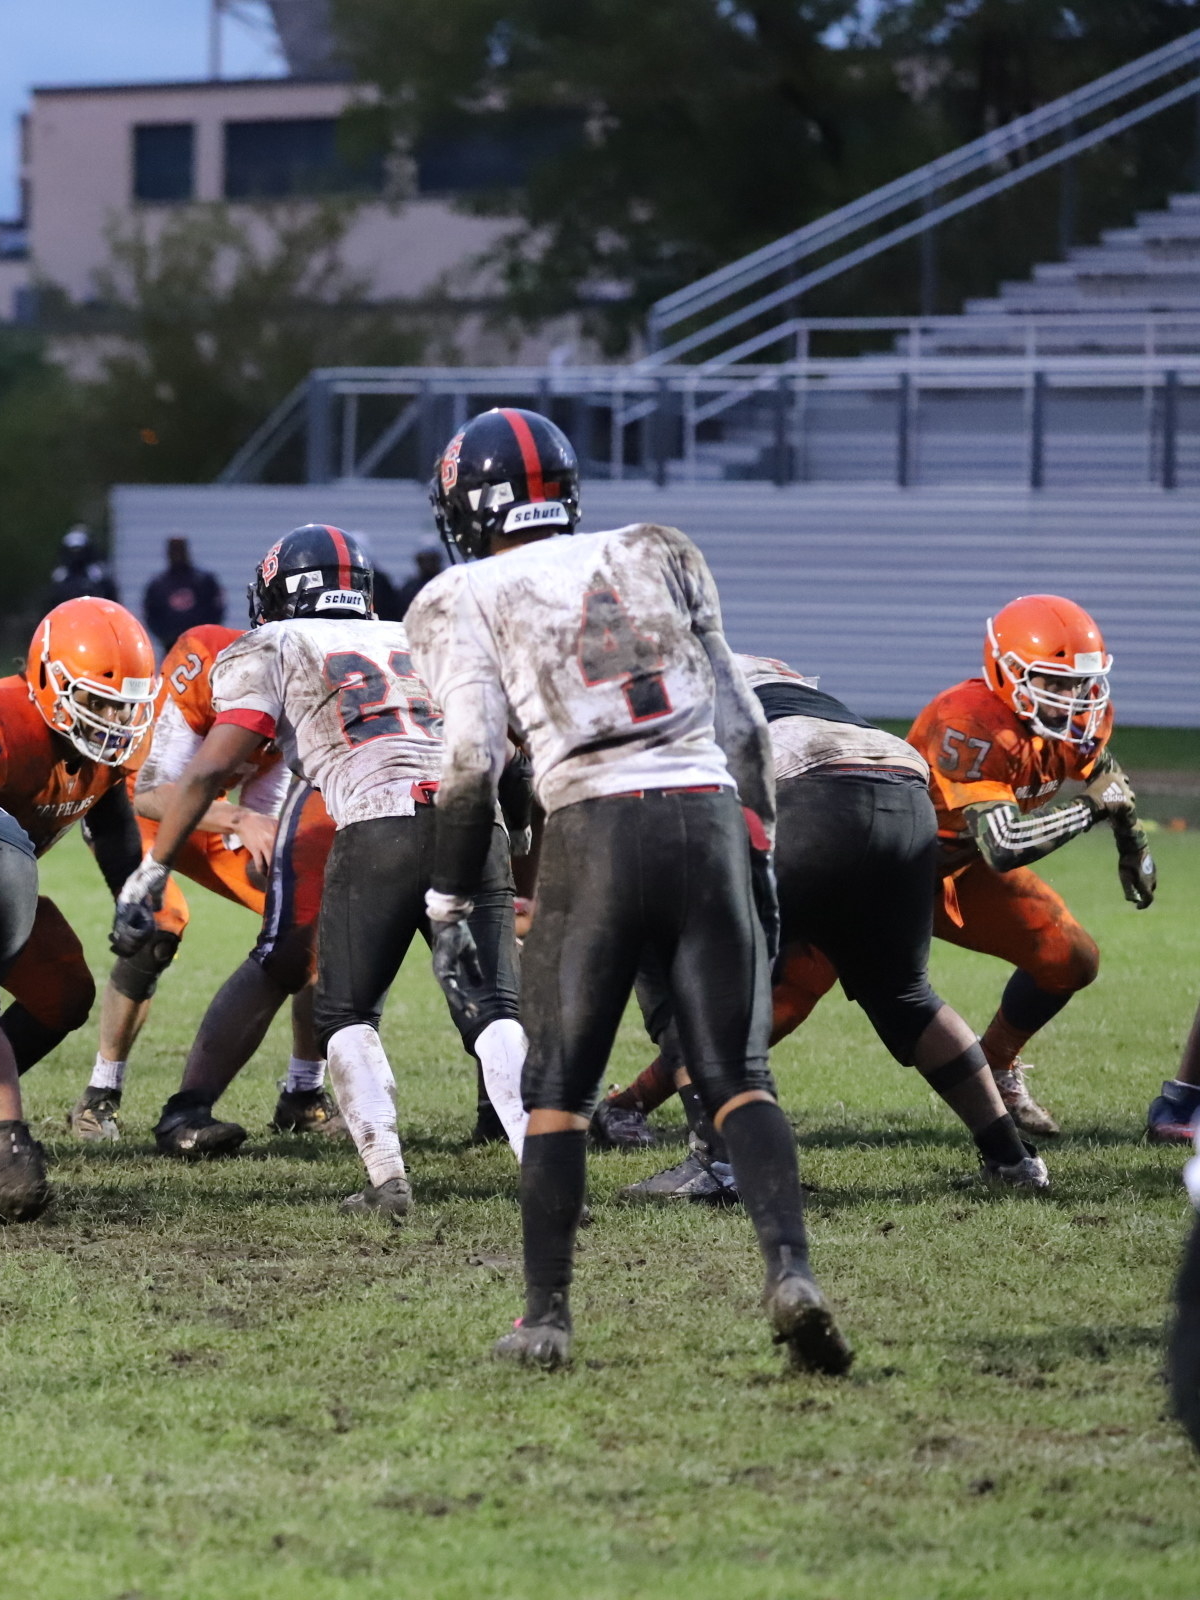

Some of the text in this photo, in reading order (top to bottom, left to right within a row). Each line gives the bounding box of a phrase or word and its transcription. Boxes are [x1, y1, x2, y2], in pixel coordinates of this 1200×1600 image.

[514, 506, 561, 522] schutt
[325, 593, 362, 605] schutt
[170, 653, 202, 694] 2
[577, 588, 673, 724] 4
[938, 726, 992, 779] 57
